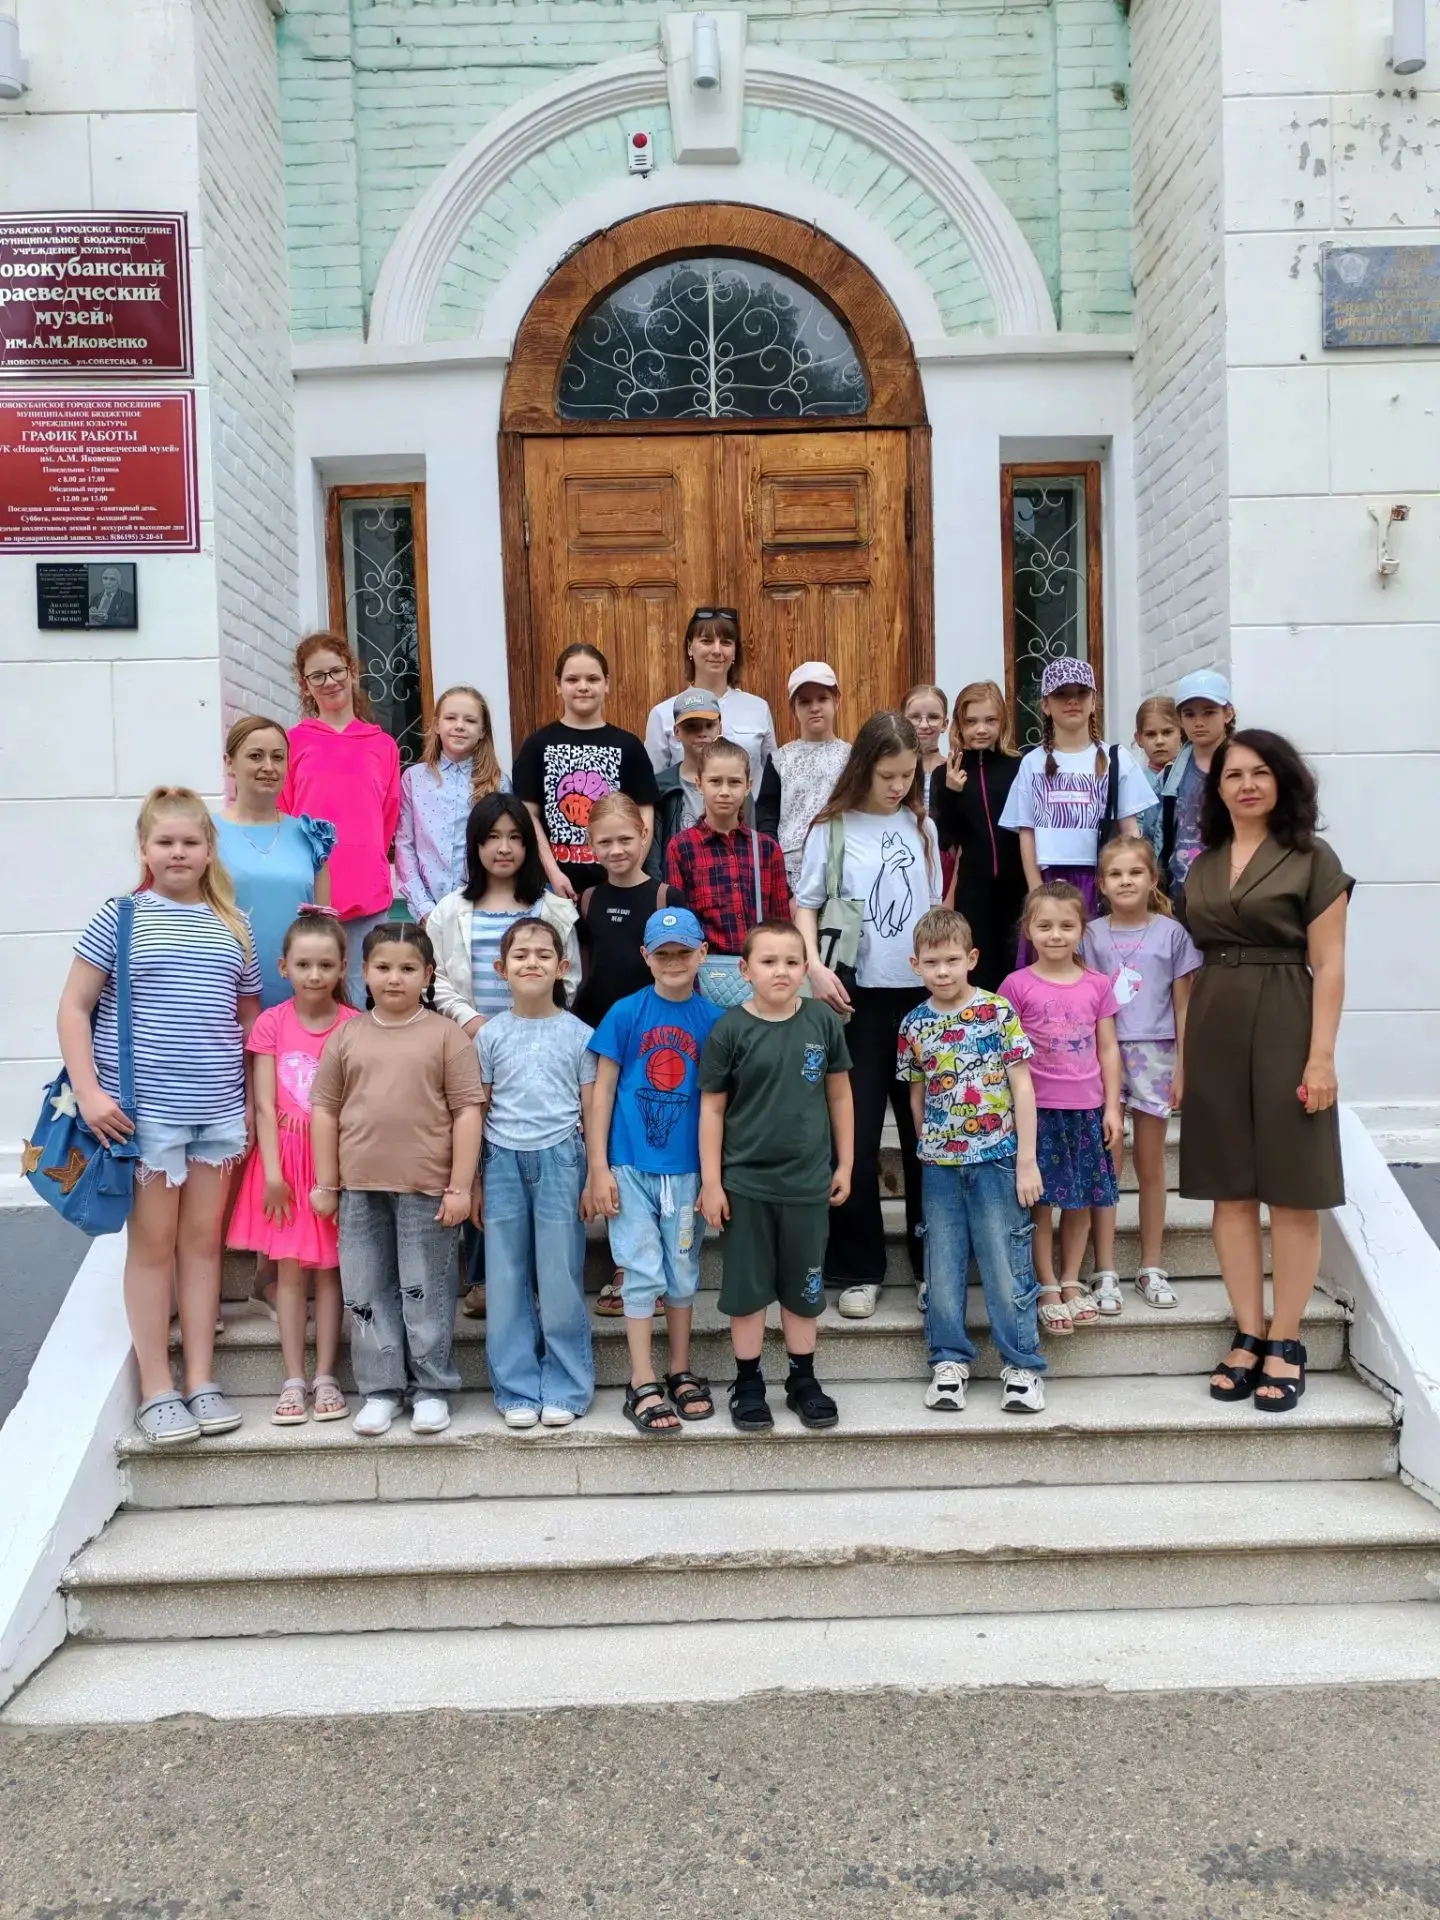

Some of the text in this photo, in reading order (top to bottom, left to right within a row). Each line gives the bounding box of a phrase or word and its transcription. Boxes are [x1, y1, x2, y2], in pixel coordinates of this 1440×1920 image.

[56, 226, 111, 234] ГОРОДСКОЕ
[115, 226, 172, 235] ПОСЕЛЕНИЕ
[83, 236, 146, 245] БЮДЖЕТНОЕ
[12, 247, 131, 256] УЧРЕЖДЕНИЕ КУЛЬТУРЫ
[36, 307, 114, 330] музей»
[66, 401, 112, 409] ГОРОДСКОЕ
[31, 420, 85, 428] УЧРЕЖДЕНИЕ
[21, 430, 138, 441] ГРАФИК РАБОТЫ
[86, 444, 147, 455] краеведческий
[81, 454, 122, 463] Яковенко
[48, 485, 116, 494] Обеденный перерыв
[100, 505, 140, 513] санитарный
